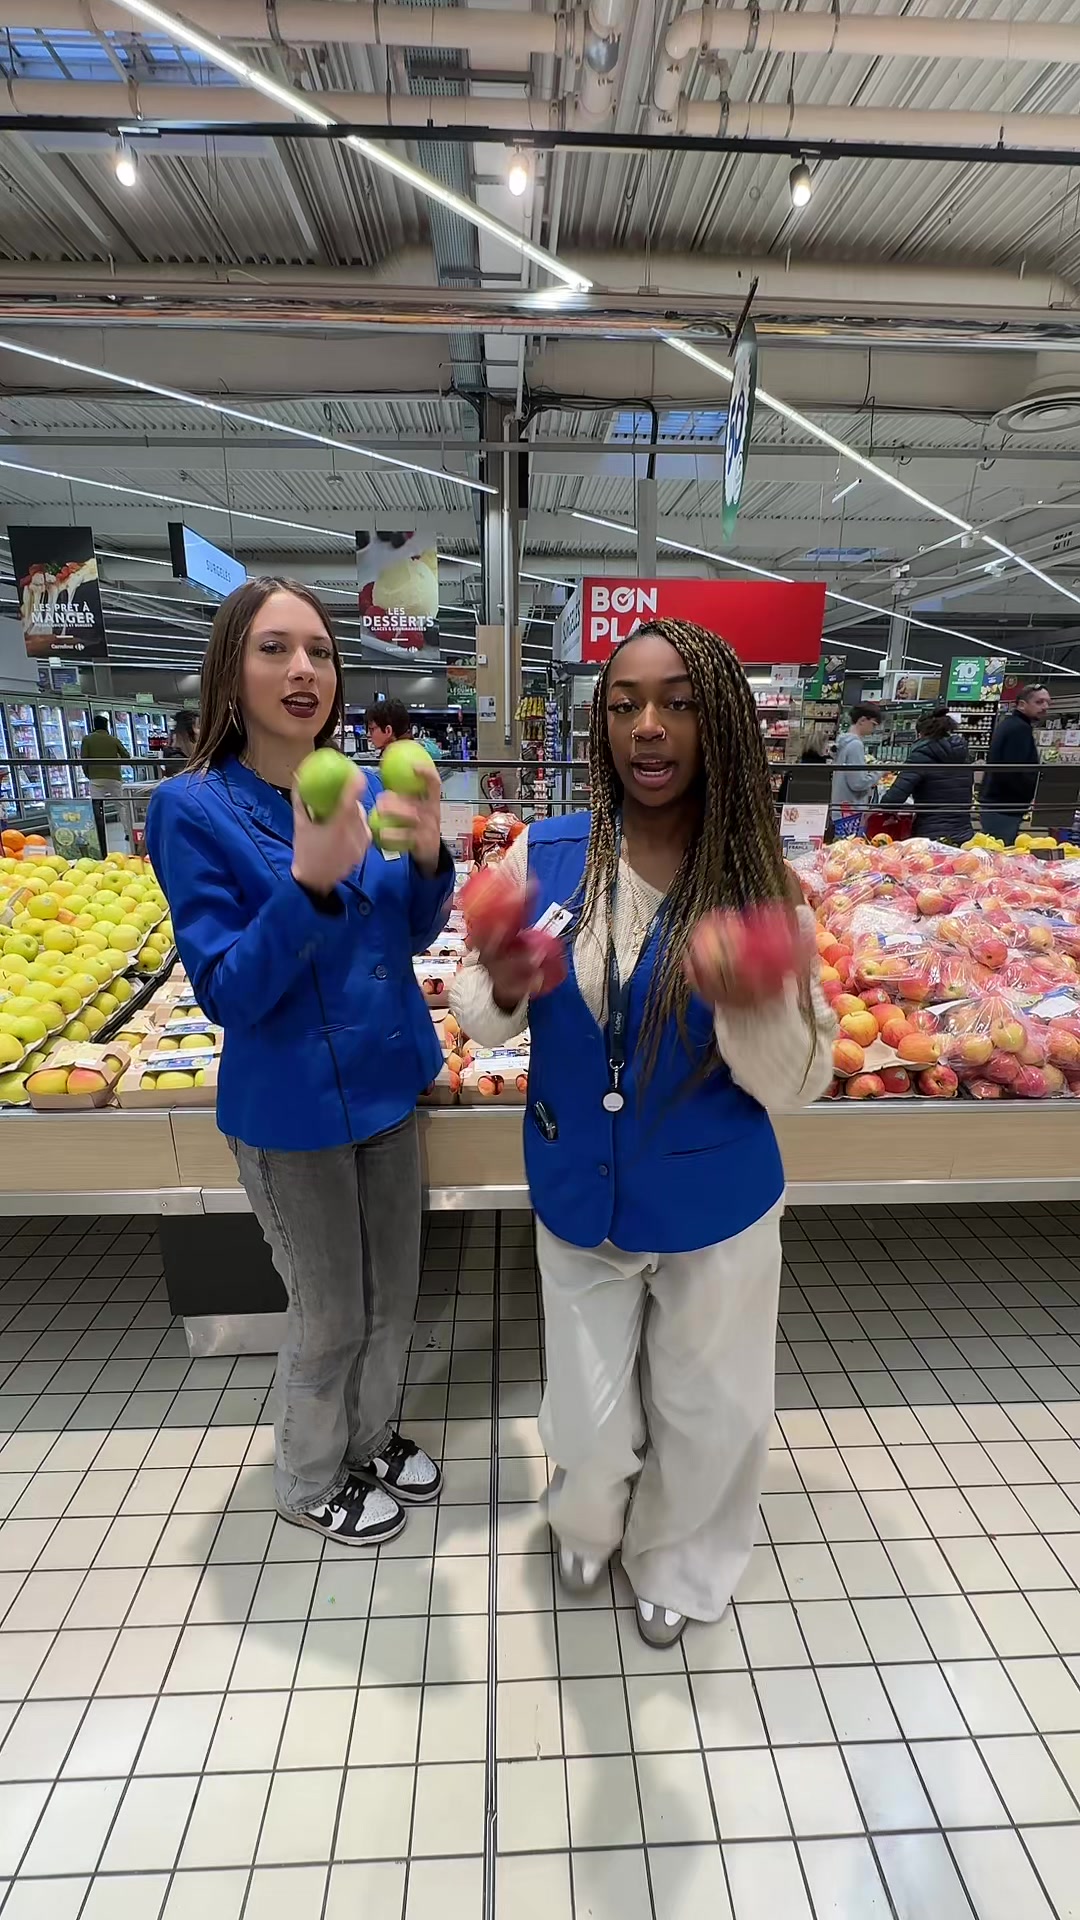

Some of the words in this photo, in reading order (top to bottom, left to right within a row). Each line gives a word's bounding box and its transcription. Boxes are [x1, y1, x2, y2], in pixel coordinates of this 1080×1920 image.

[590, 586, 658, 613] BON
[33, 603, 51, 612] LES
[388, 607, 405, 615] LES
[31, 612, 95, 623] MANGER
[362, 616, 434, 627] DESSERTS
